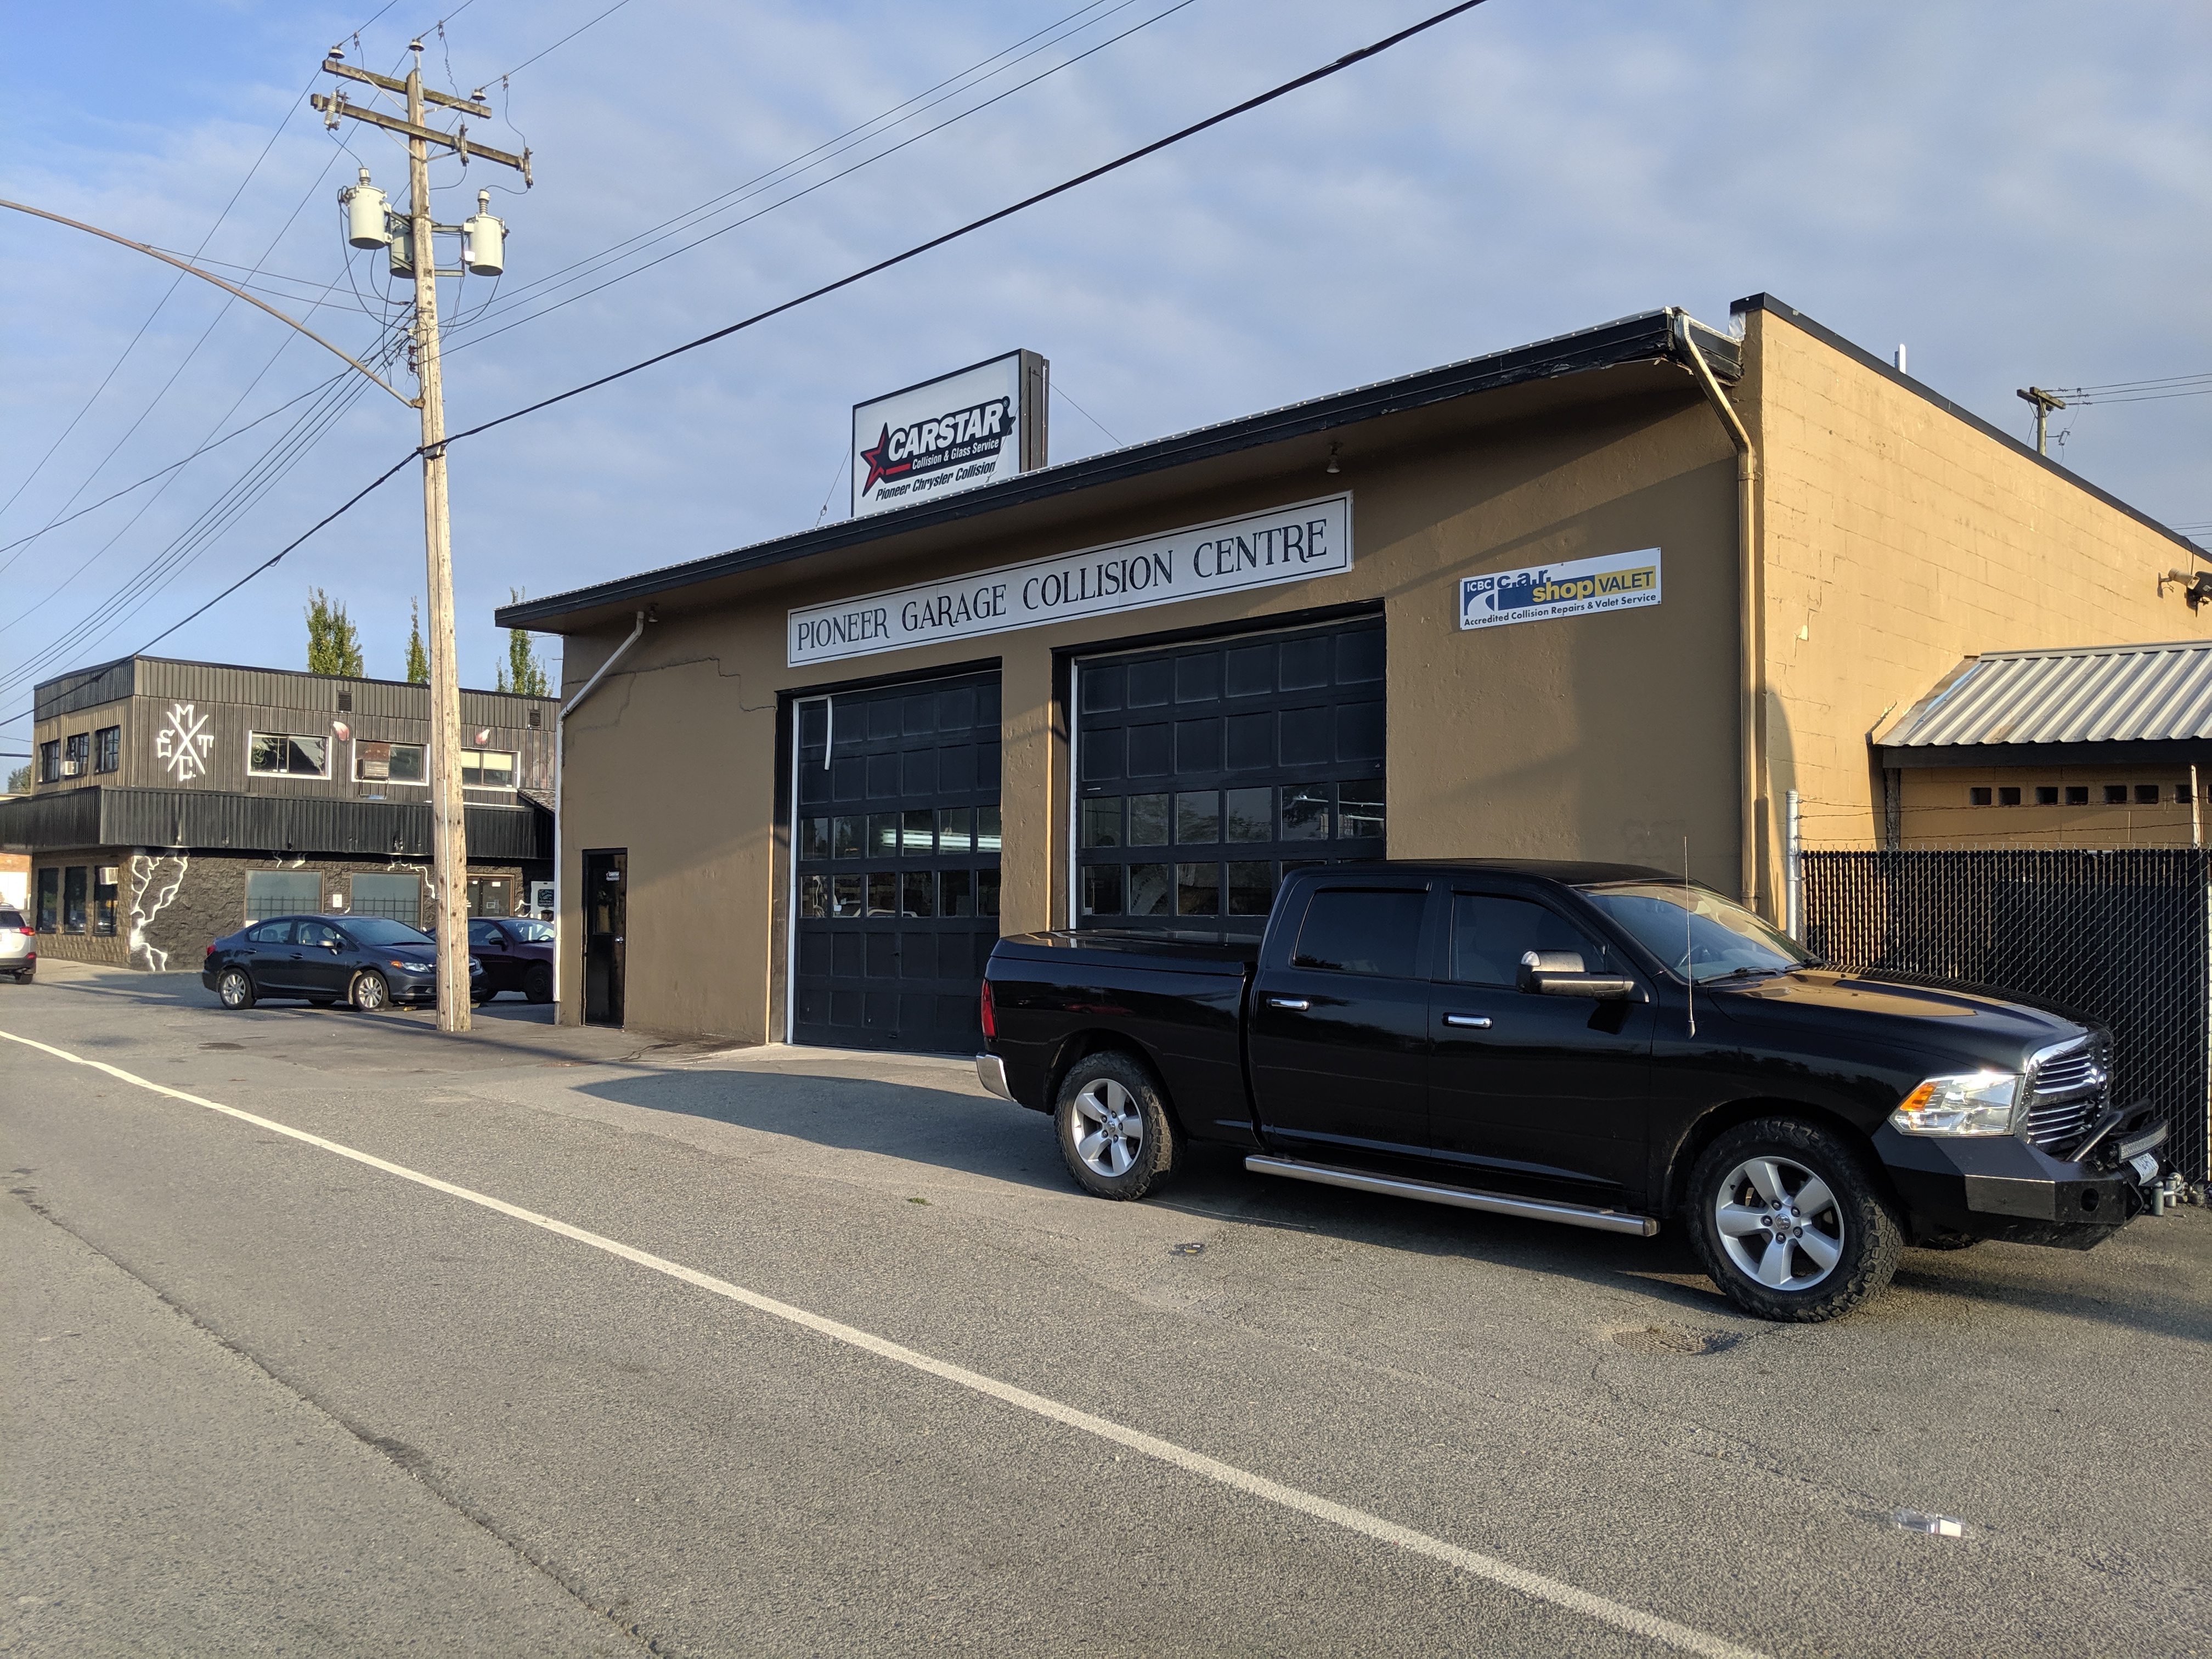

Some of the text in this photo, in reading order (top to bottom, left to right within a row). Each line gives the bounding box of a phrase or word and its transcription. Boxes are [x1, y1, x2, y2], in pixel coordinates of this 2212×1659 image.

[888, 403, 1003, 462] CARSTAR
[912, 439, 1000, 470] Collision & Glass Service
[876, 461, 996, 501] Pioneer Chrysler Collision
[797, 518, 1327, 651] PIONEER GARAGE COLLISION CENTRE
[1466, 579, 1492, 592] ICBC
[1532, 571, 1654, 602] shop VALET
[1464, 612, 1509, 627] Accredited
[1511, 608, 1549, 620] Collision
[1551, 603, 1585, 616] Repairs
[1595, 597, 1619, 607] Valet
[1621, 593, 1656, 605] Service
